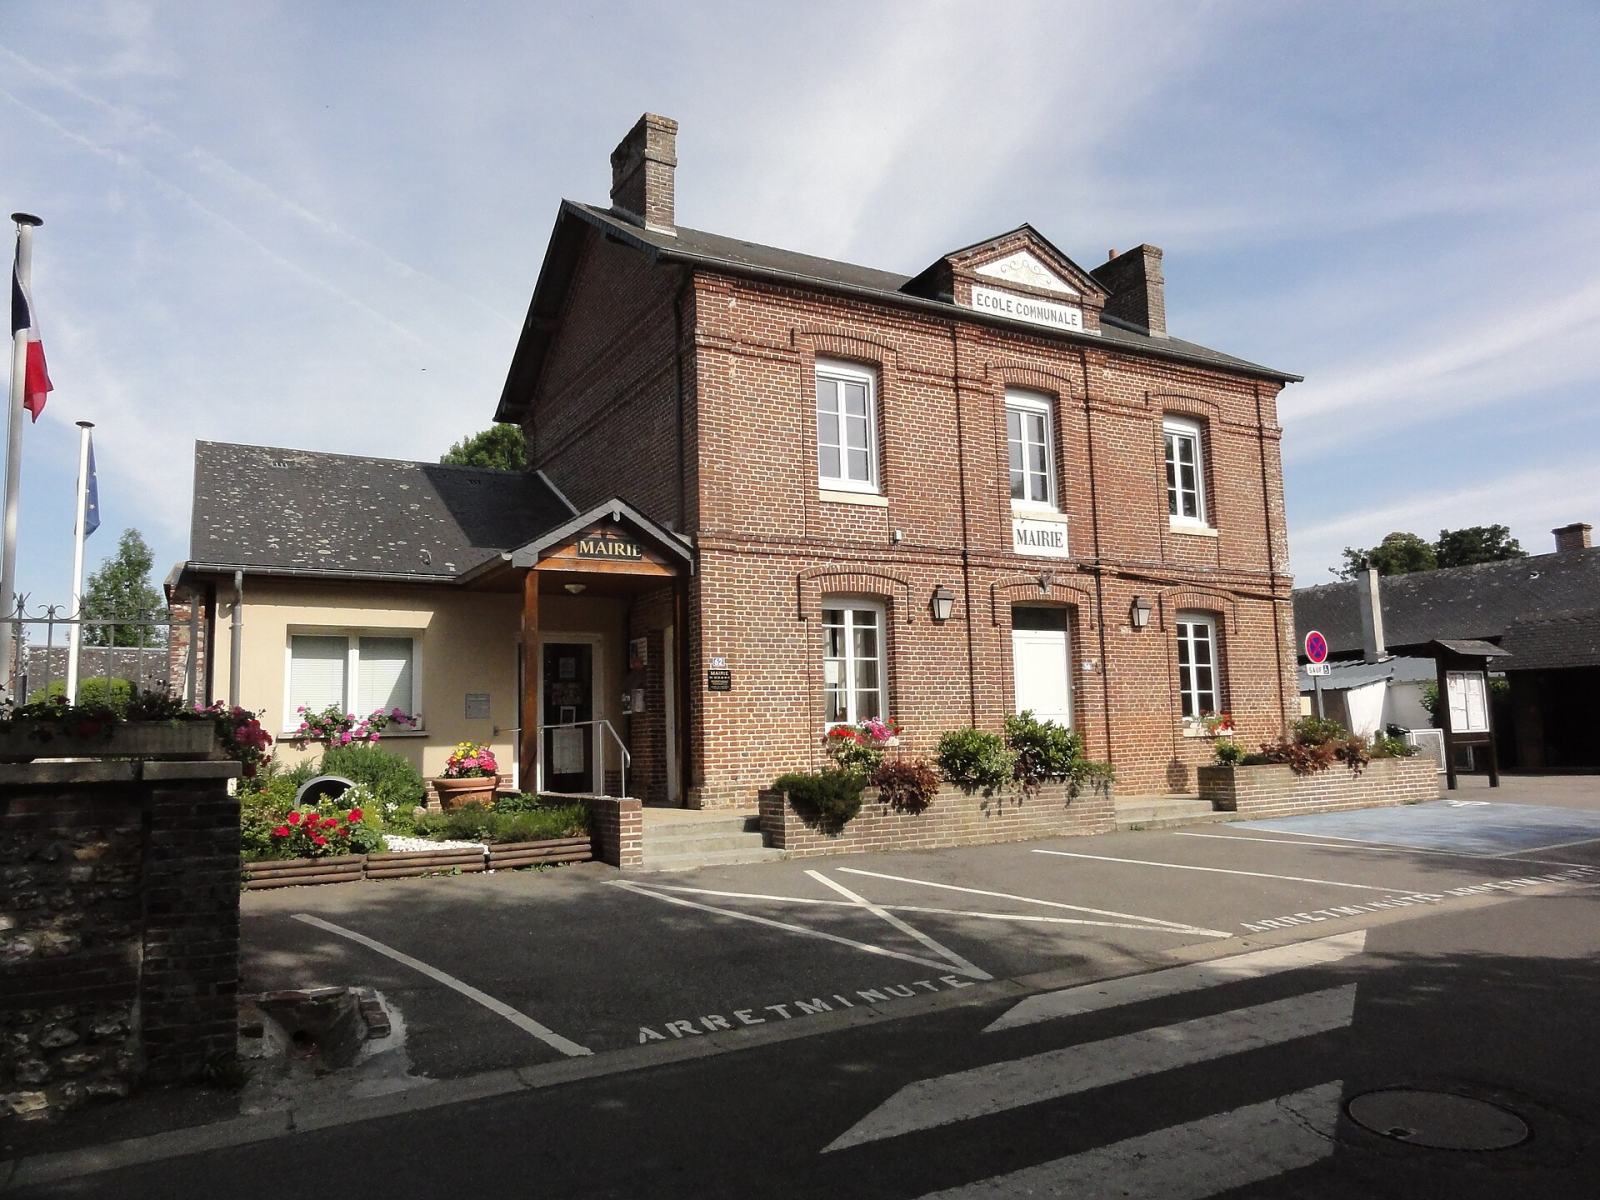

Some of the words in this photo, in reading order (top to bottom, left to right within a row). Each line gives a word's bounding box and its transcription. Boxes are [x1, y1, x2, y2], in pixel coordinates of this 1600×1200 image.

[976, 293, 1013, 313] ECOLE
[1016, 302, 1078, 326] COMMUNALE
[1016, 528, 1064, 548] MAIRIE
[579, 540, 642, 557] MAIRIE
